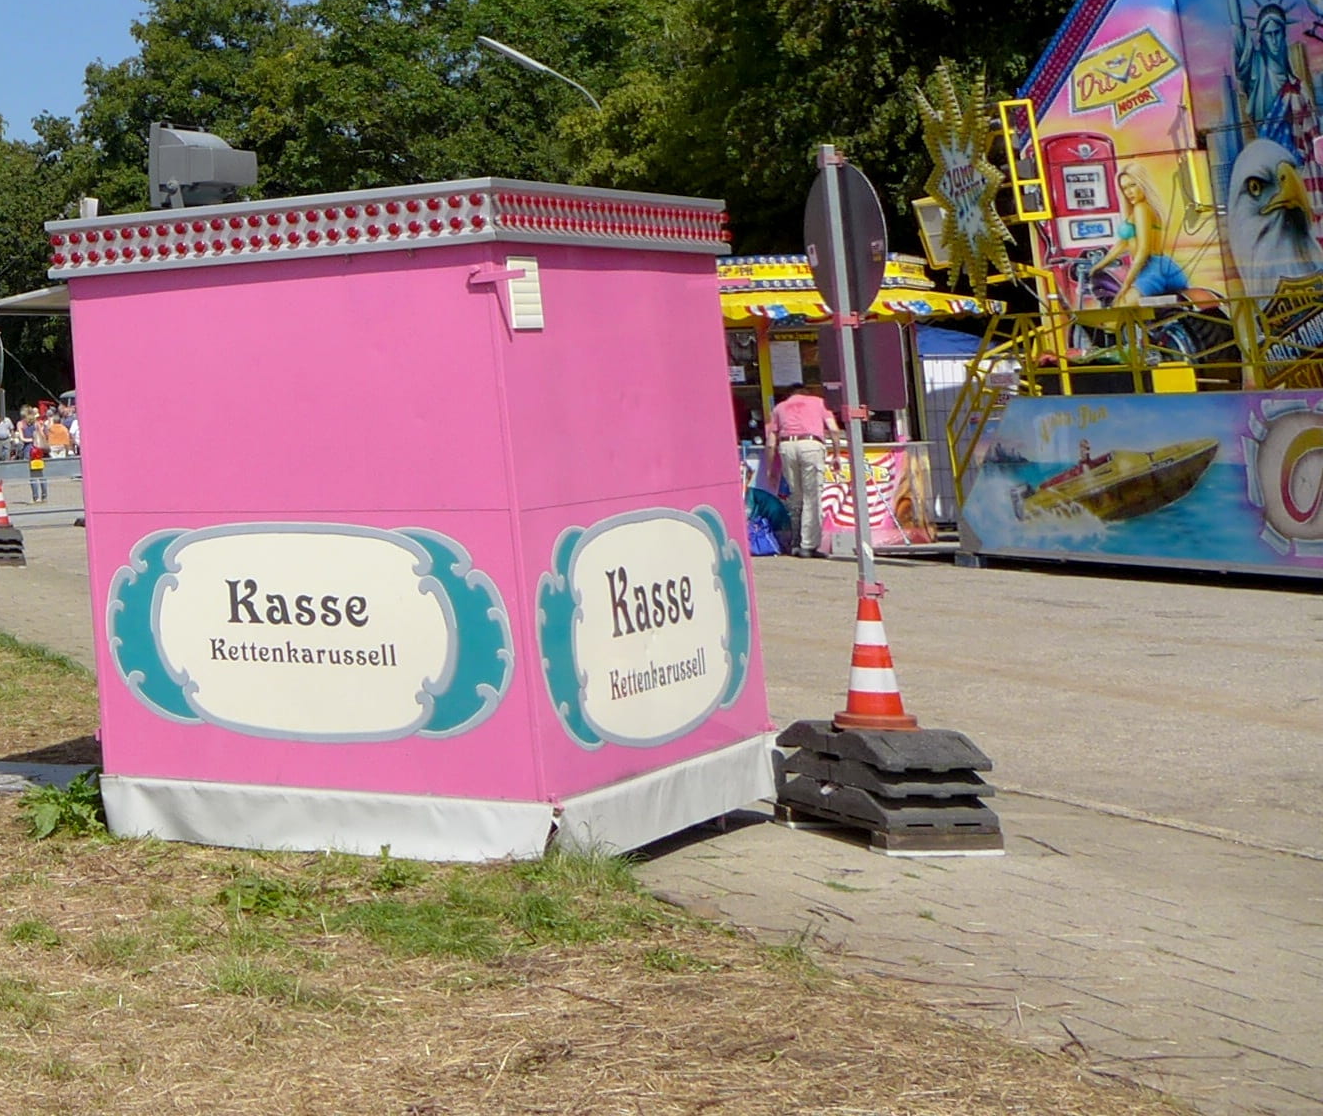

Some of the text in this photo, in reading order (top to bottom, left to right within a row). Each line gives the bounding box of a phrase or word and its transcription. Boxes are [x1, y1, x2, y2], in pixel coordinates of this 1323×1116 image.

[1117, 90, 1154, 114] MOTOR
[225, 578, 369, 627] Kasse
[605, 566, 695, 638] Kasse
[210, 638, 397, 666] Kettenkarussell
[609, 647, 706, 700] Kettenkarussell
